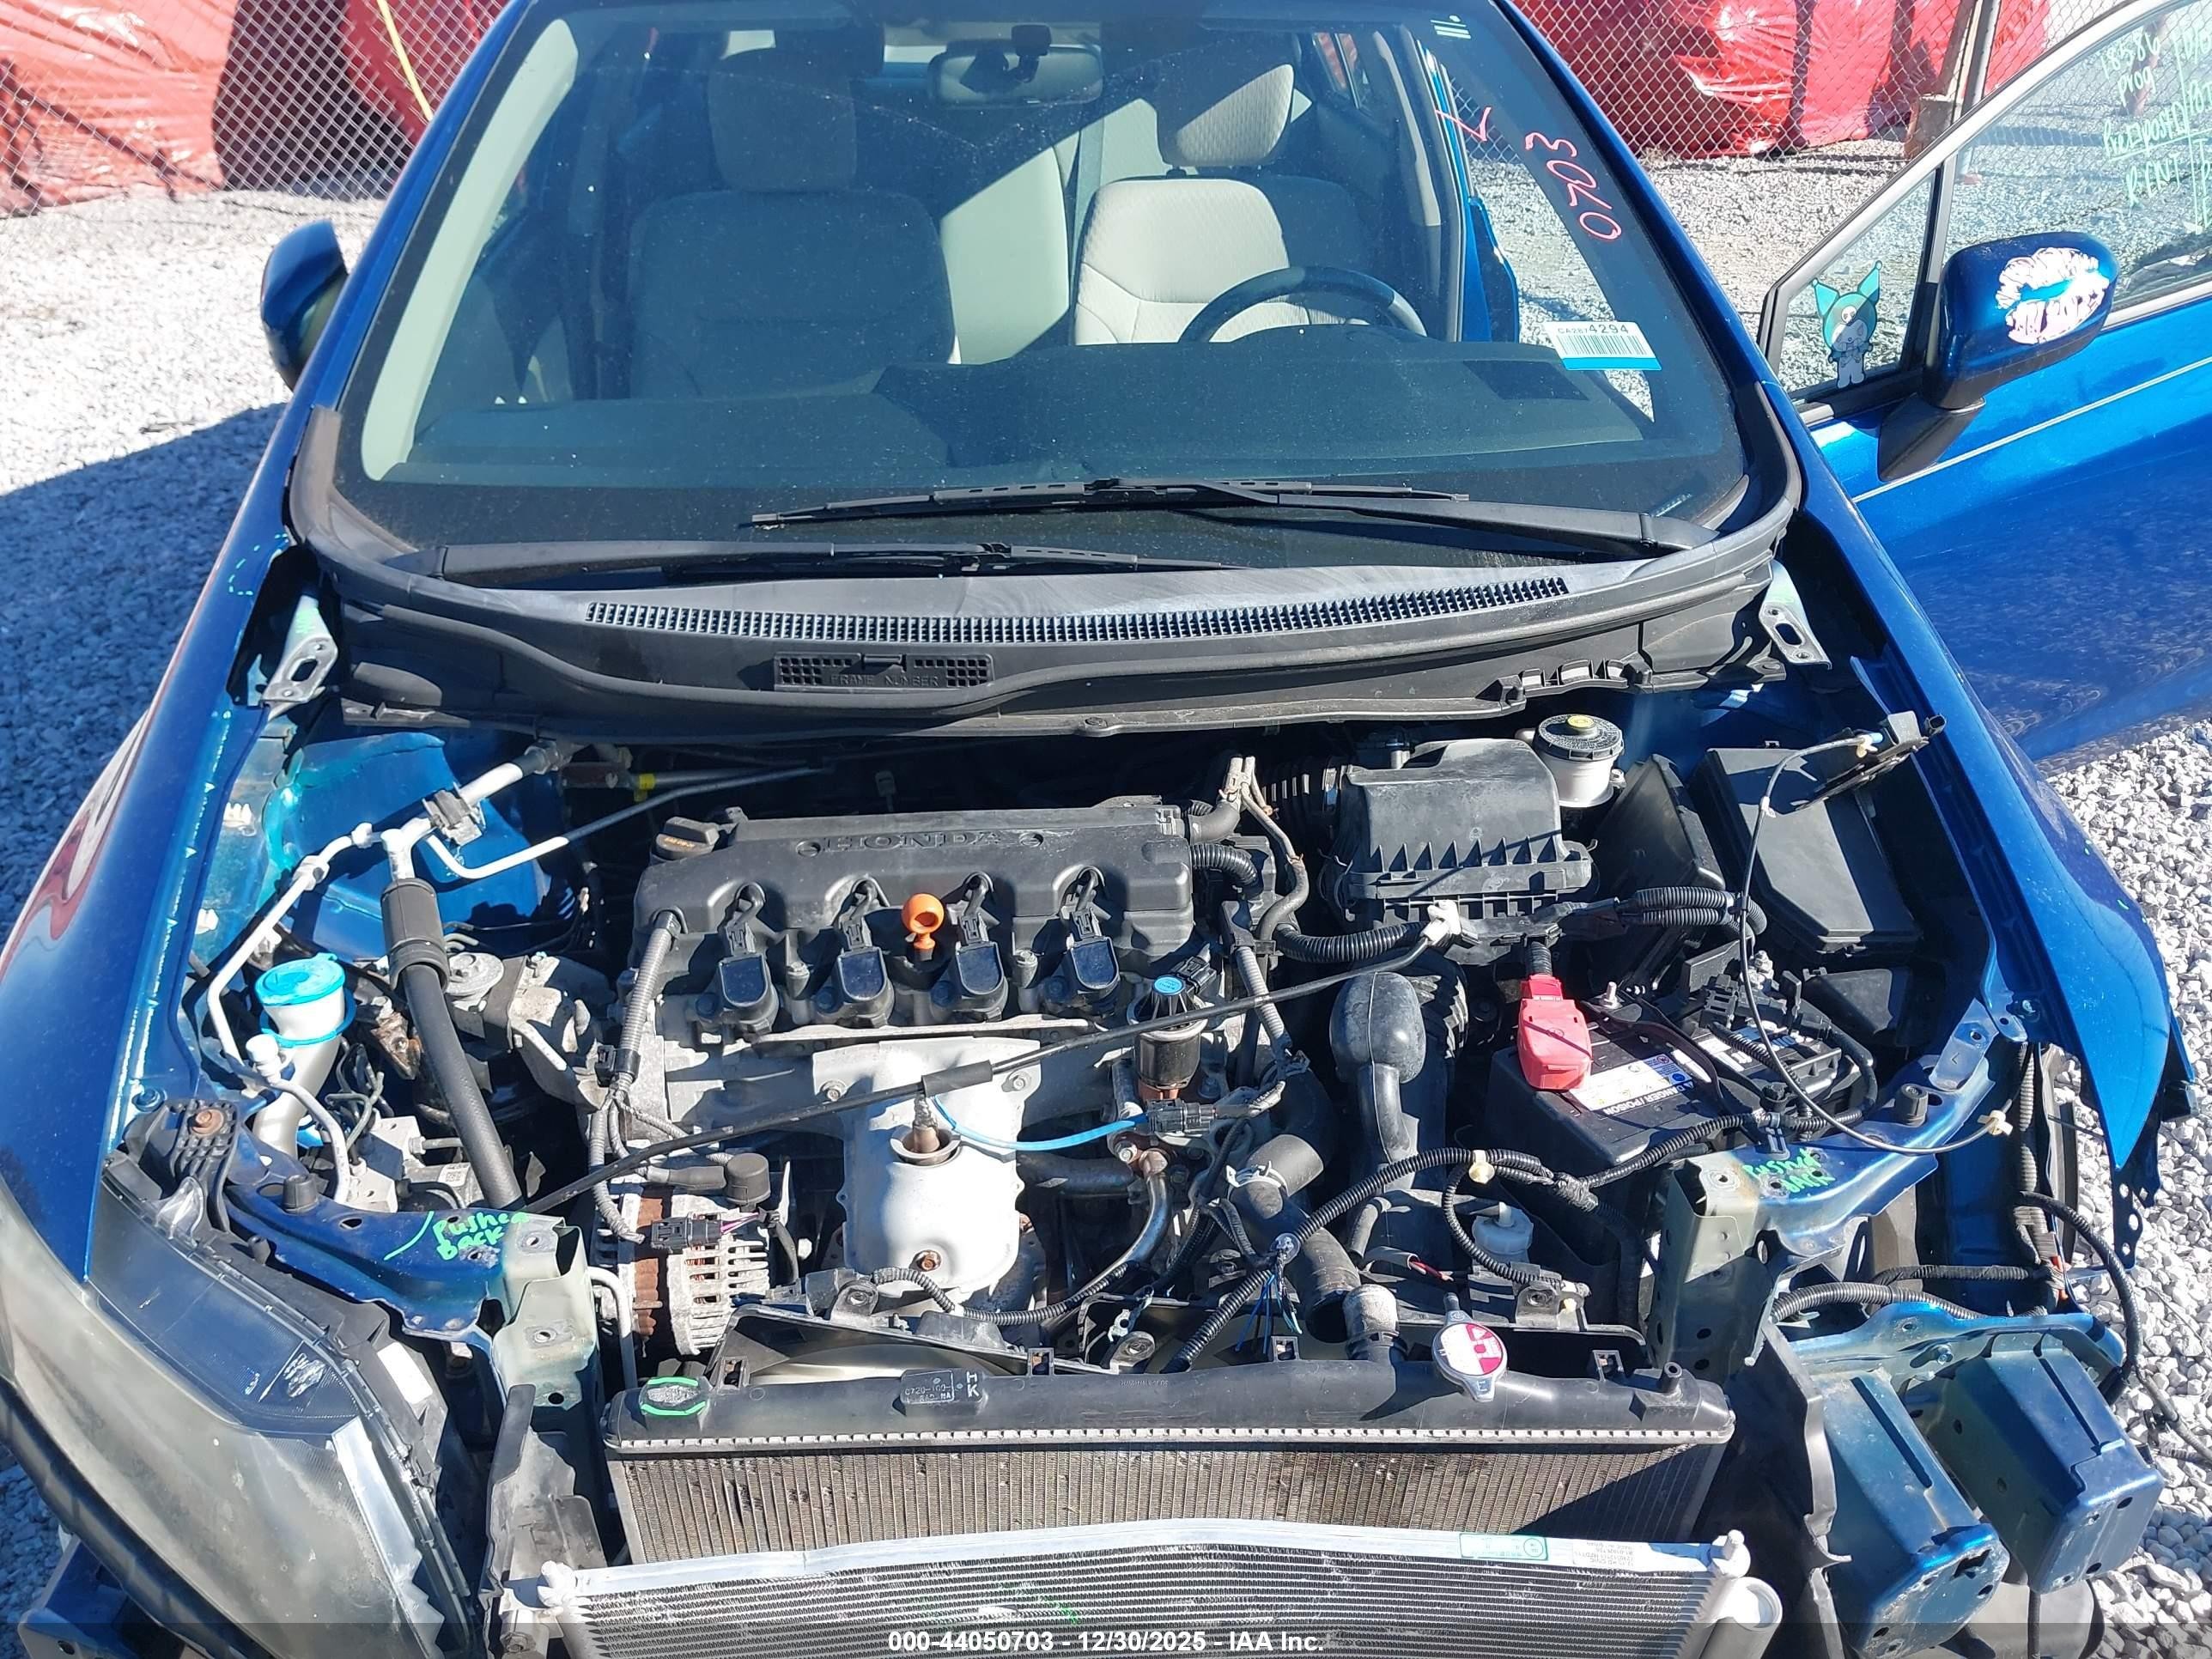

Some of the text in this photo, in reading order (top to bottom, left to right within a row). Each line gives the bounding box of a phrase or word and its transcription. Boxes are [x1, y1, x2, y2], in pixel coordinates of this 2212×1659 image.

[830, 674, 939, 687] FRAME NUMBER
[822, 832, 1001, 852] HONDA
